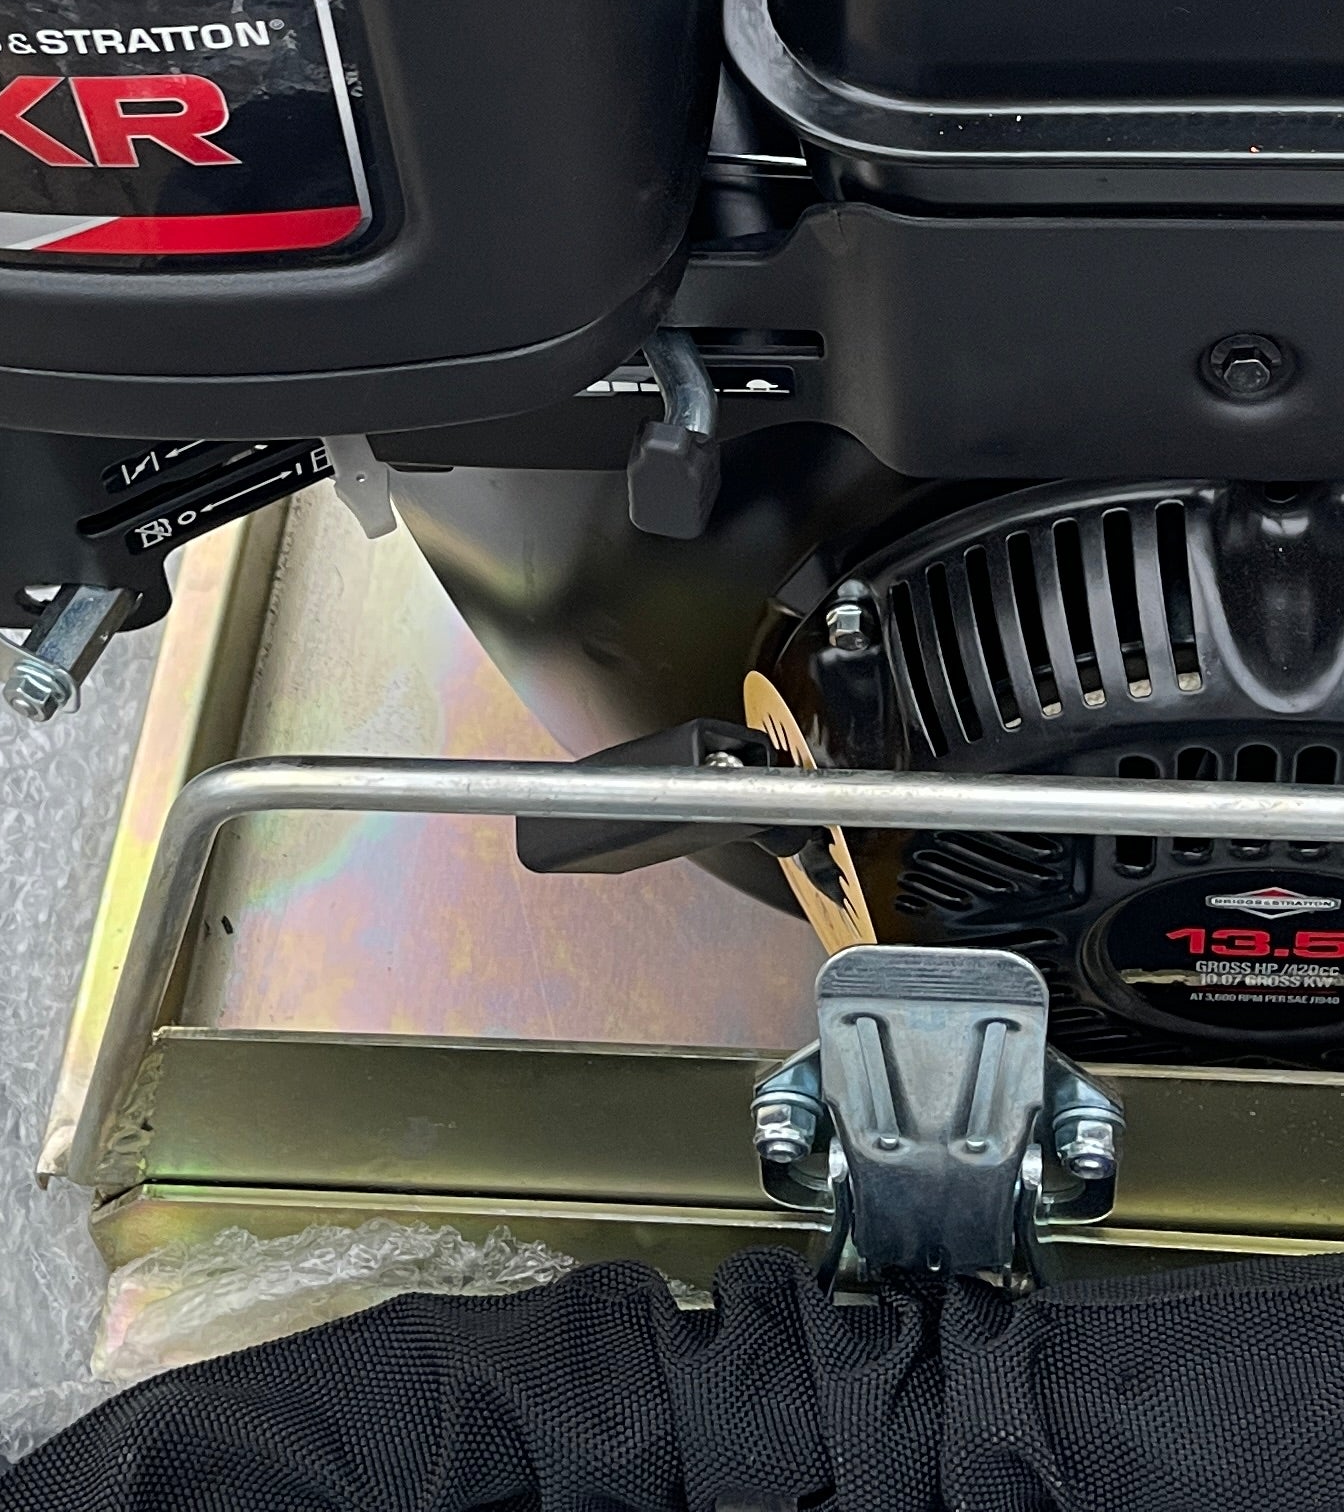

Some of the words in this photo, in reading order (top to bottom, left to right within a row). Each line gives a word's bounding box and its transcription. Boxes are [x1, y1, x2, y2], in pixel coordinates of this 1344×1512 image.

[1195, 960, 1252, 975] GROSS
[1255, 962, 1278, 975] HP
[1200, 973, 1242, 986] 10.07
[1244, 974, 1301, 988] GROSS
[1189, 992, 1204, 1001] AT
[1238, 993, 1263, 1002] RPM
[1264, 994, 1286, 1003] PER
[1287, 995, 1309, 1004] SAE
